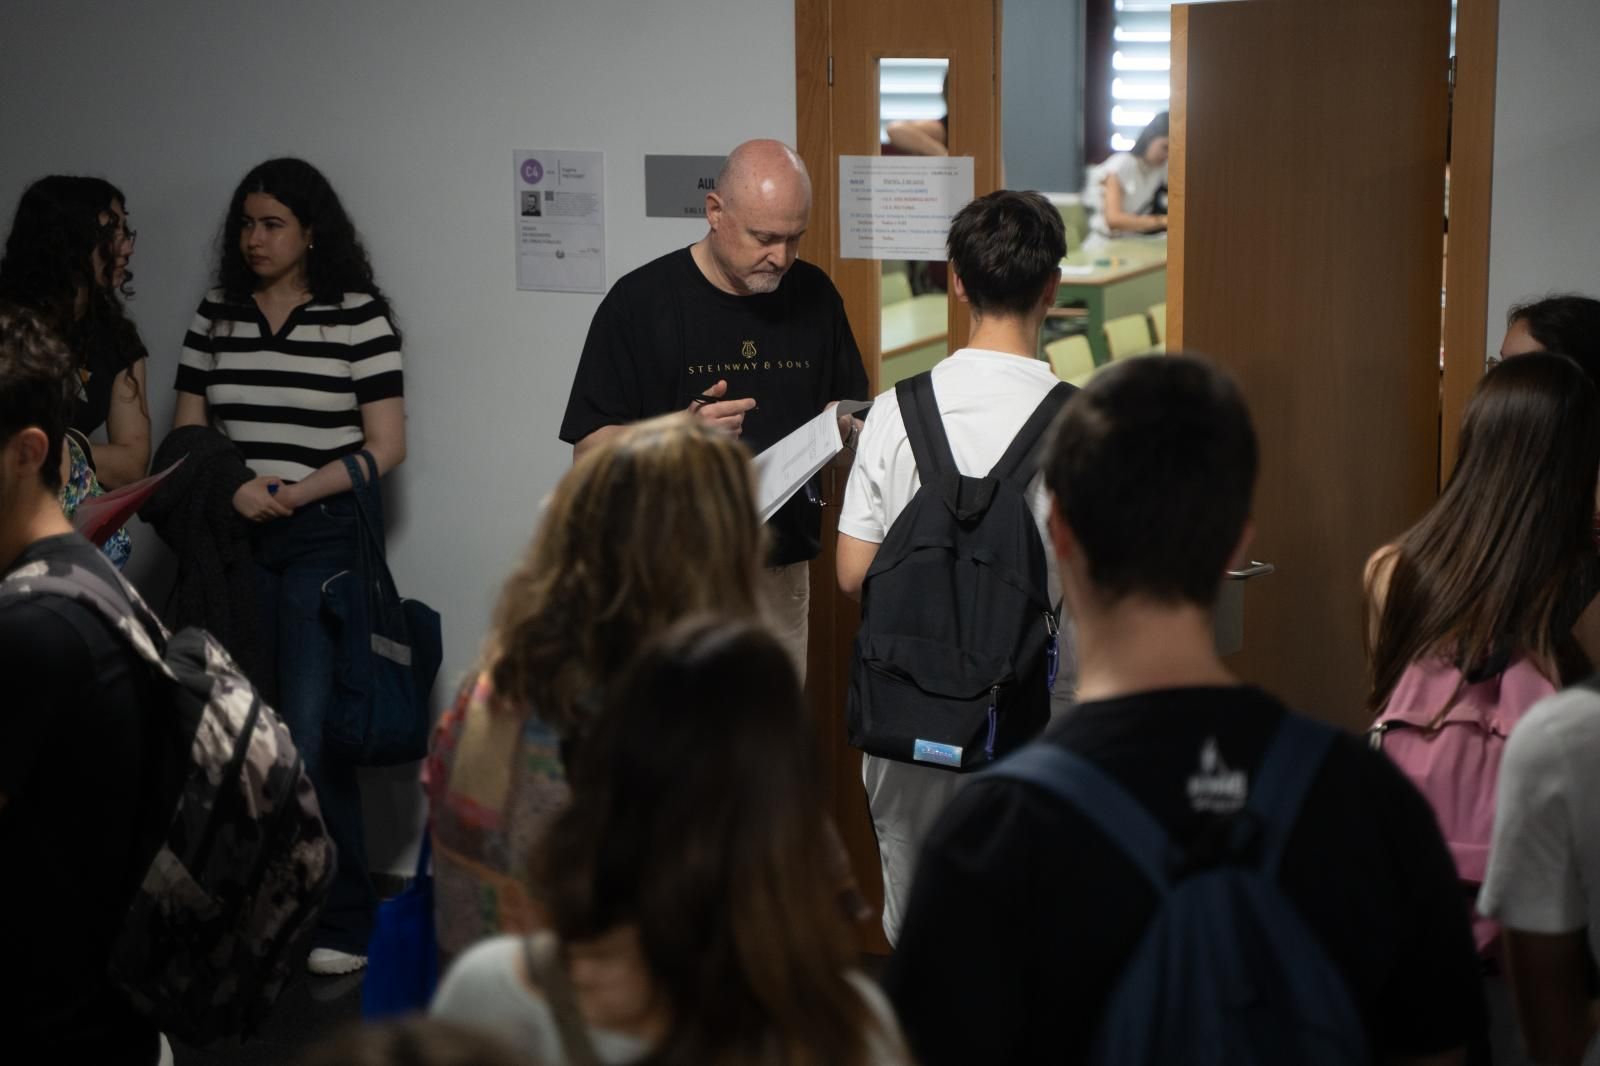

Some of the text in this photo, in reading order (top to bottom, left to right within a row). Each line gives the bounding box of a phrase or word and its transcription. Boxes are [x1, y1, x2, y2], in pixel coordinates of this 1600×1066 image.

[697, 177, 716, 190] AUL
[688, 360, 810, 375] STEINWAY & SONS
